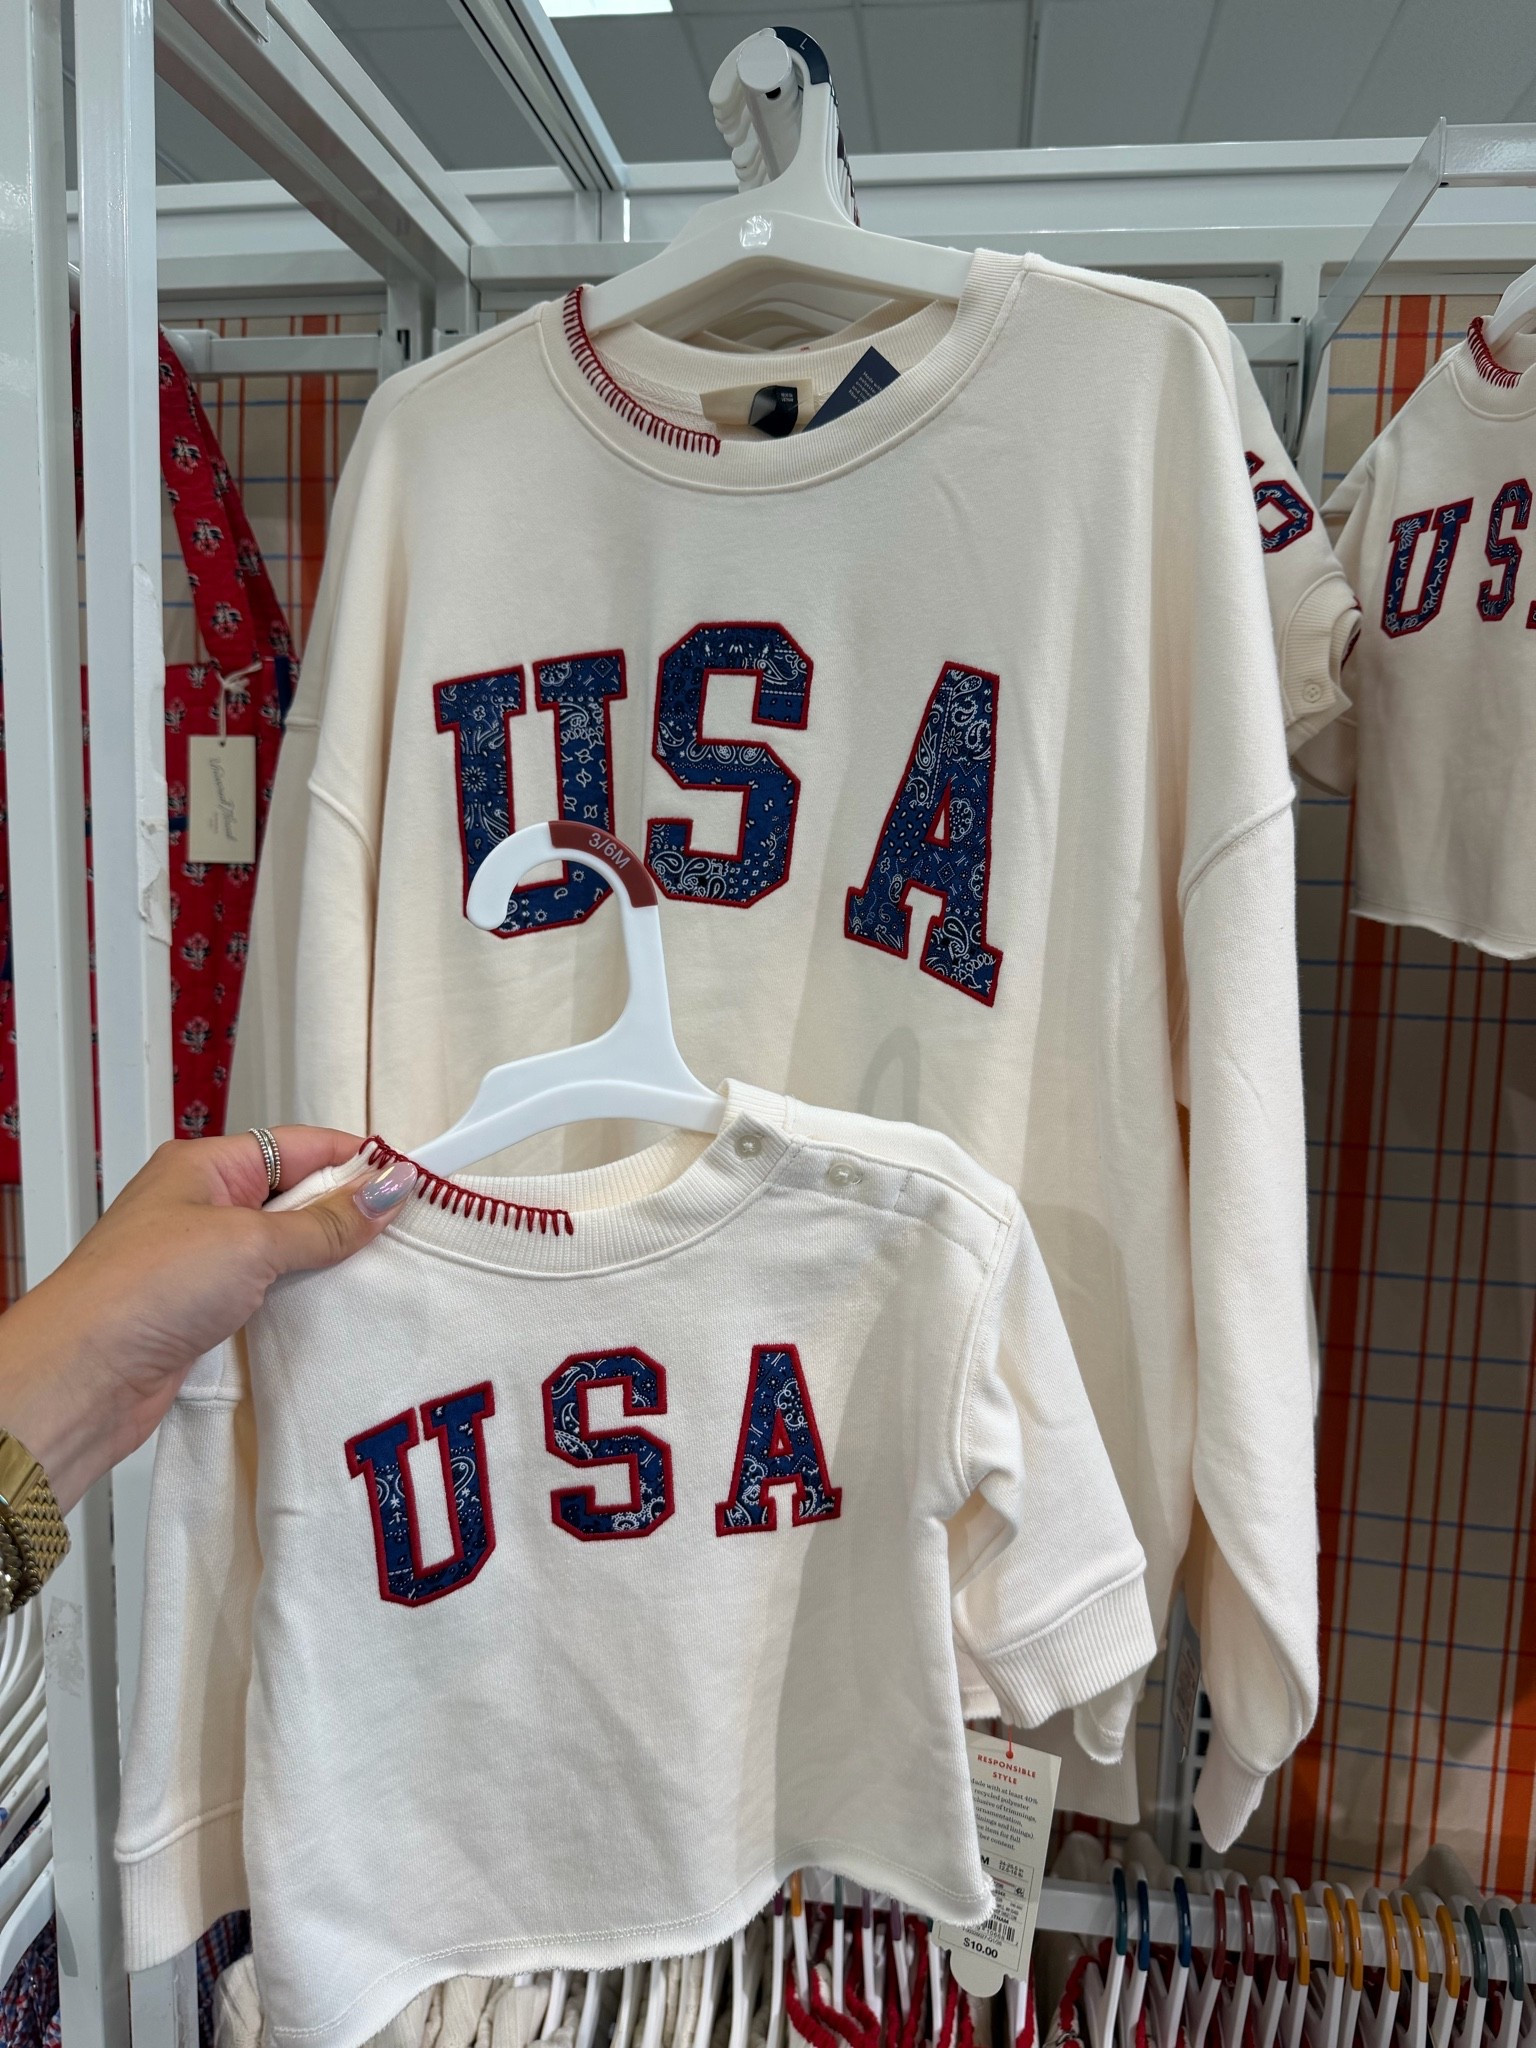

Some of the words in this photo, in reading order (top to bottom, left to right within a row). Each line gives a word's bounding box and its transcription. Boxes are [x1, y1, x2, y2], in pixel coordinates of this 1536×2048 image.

[799, 37, 808, 51] L
[1381, 478, 1536, 640] US
[432, 621, 1004, 1008] USA
[588, 833, 631, 870] 3/6M
[344, 1343, 843, 1608] USA
[977, 1754, 1037, 1779] RESPONSIBLE
[992, 1771, 1018, 1785] STYLE
[974, 1789, 1000, 1801] recycled
[1000, 1797, 1029, 1811] polyester
[986, 1783, 1001, 1793] with
[1008, 1790, 1024, 1800] least
[985, 1825, 1000, 1836] item
[1000, 1830, 1010, 1839] for
[1010, 1834, 1021, 1844] full
[998, 1822, 1009, 1831] and
[963, 1937, 998, 1959] $10.00
